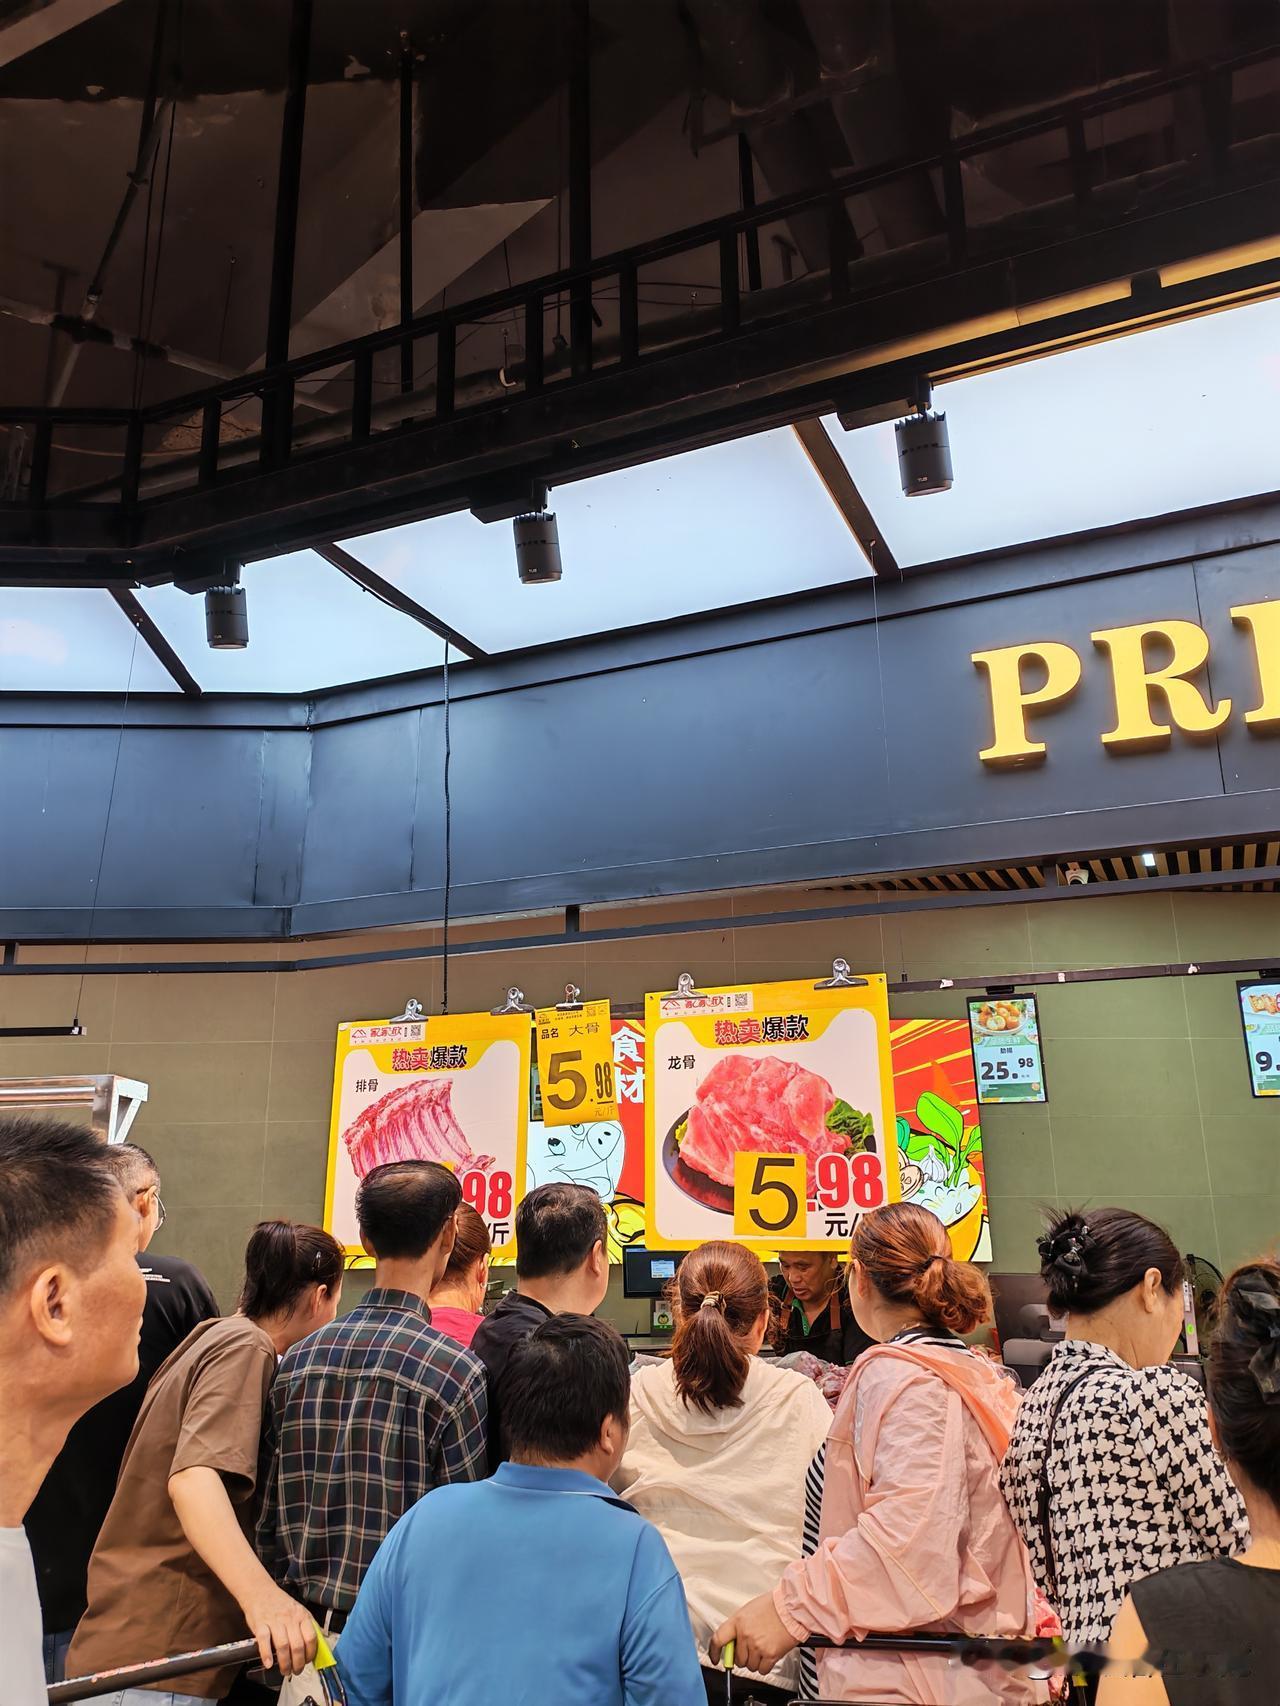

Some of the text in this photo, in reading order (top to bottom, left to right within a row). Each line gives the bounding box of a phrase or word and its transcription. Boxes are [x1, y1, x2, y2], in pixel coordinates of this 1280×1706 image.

[541, 1021, 600, 1040] 品名 大骨
[714, 1014, 809, 1046] 热卖爆款
[392, 1045, 468, 1071] 热卖爆款
[667, 1054, 696, 1070] 龙骨
[980, 1057, 1034, 1081] 25.98
[355, 1078, 379, 1093] 排骨
[547, 1049, 613, 1111] 5.98
[749, 1154, 884, 1232] 5.98
